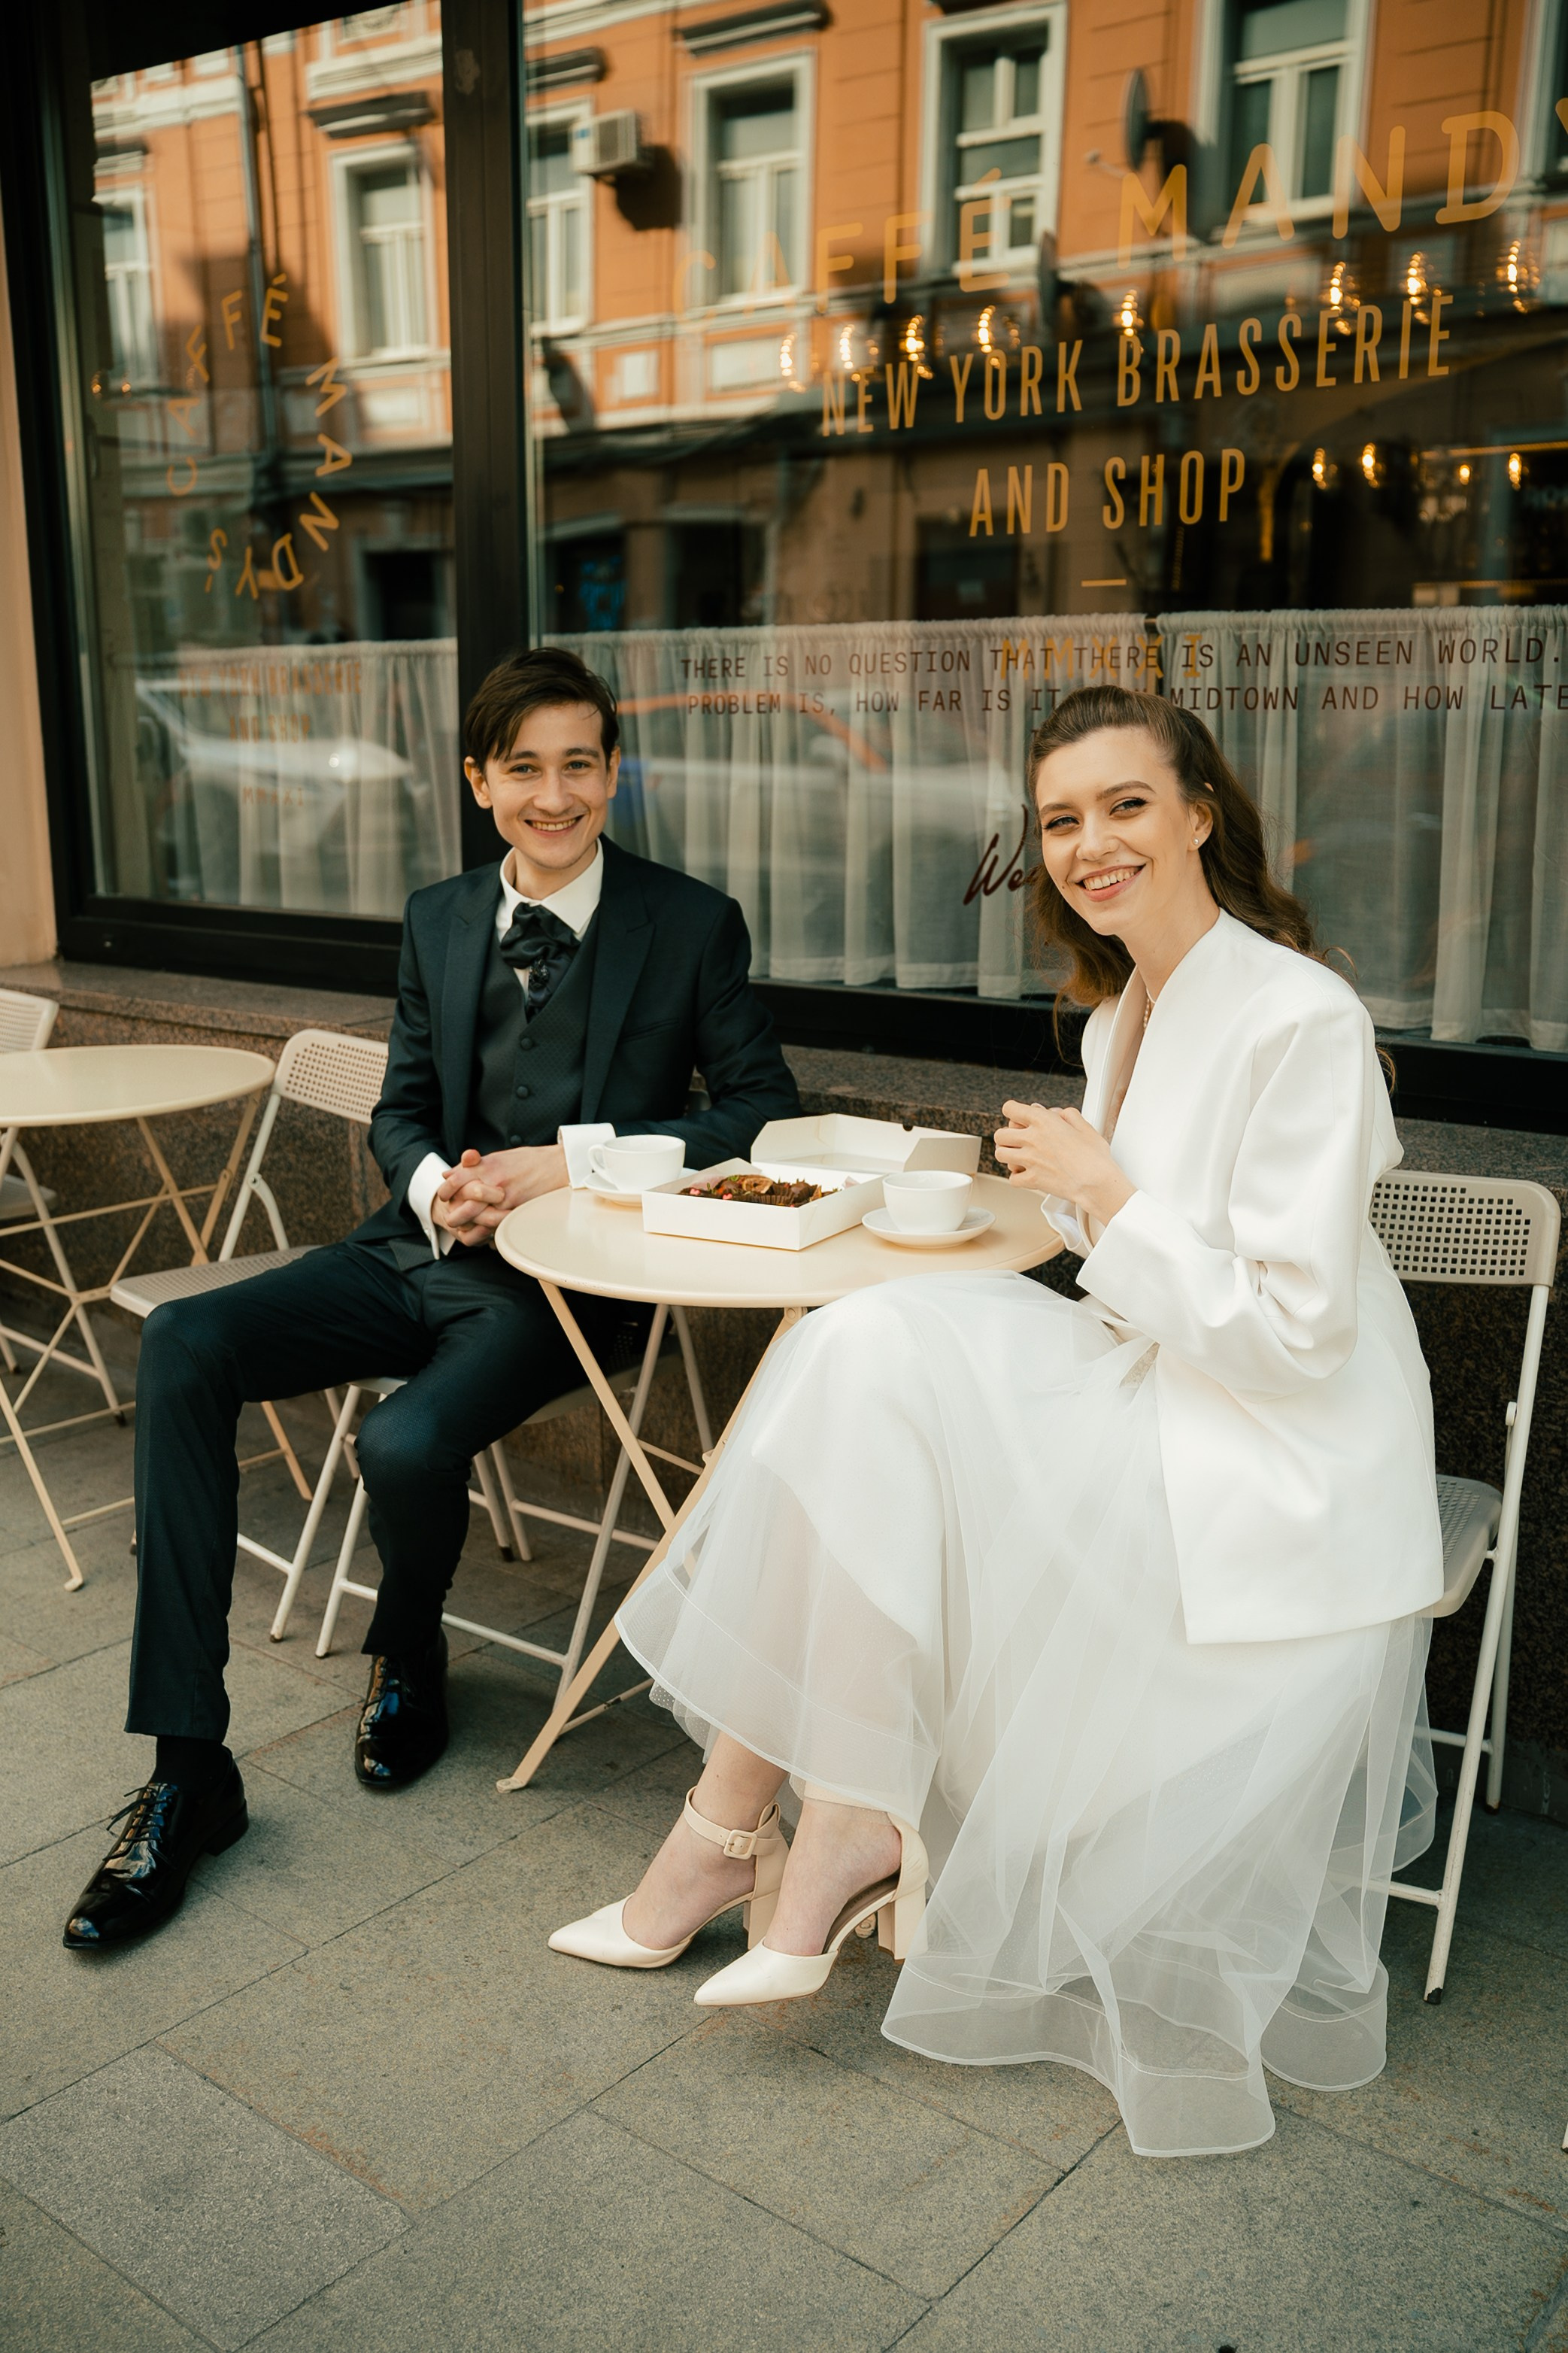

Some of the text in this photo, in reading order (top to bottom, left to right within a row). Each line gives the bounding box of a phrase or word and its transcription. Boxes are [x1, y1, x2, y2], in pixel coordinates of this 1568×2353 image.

[166, 273, 289, 496] CAFFÉ
[820, 295, 1454, 437] NEW YORK BRASSERIE
[969, 448, 1245, 537] AND SHOP
[681, 637, 1560, 679] THERE IS NO QUESTION THAT THERE IS AN UNSEEN WORLD.
[687, 694, 781, 715] PROBLEM
[798, 691, 837, 716] IS,
[855, 691, 899, 713] HOW
[917, 688, 963, 712] FAR
[981, 688, 1011, 712] IS
[1170, 686, 1299, 711] MIDTOWN
[1321, 685, 1379, 710] AND
[1403, 685, 1463, 710] HOW
